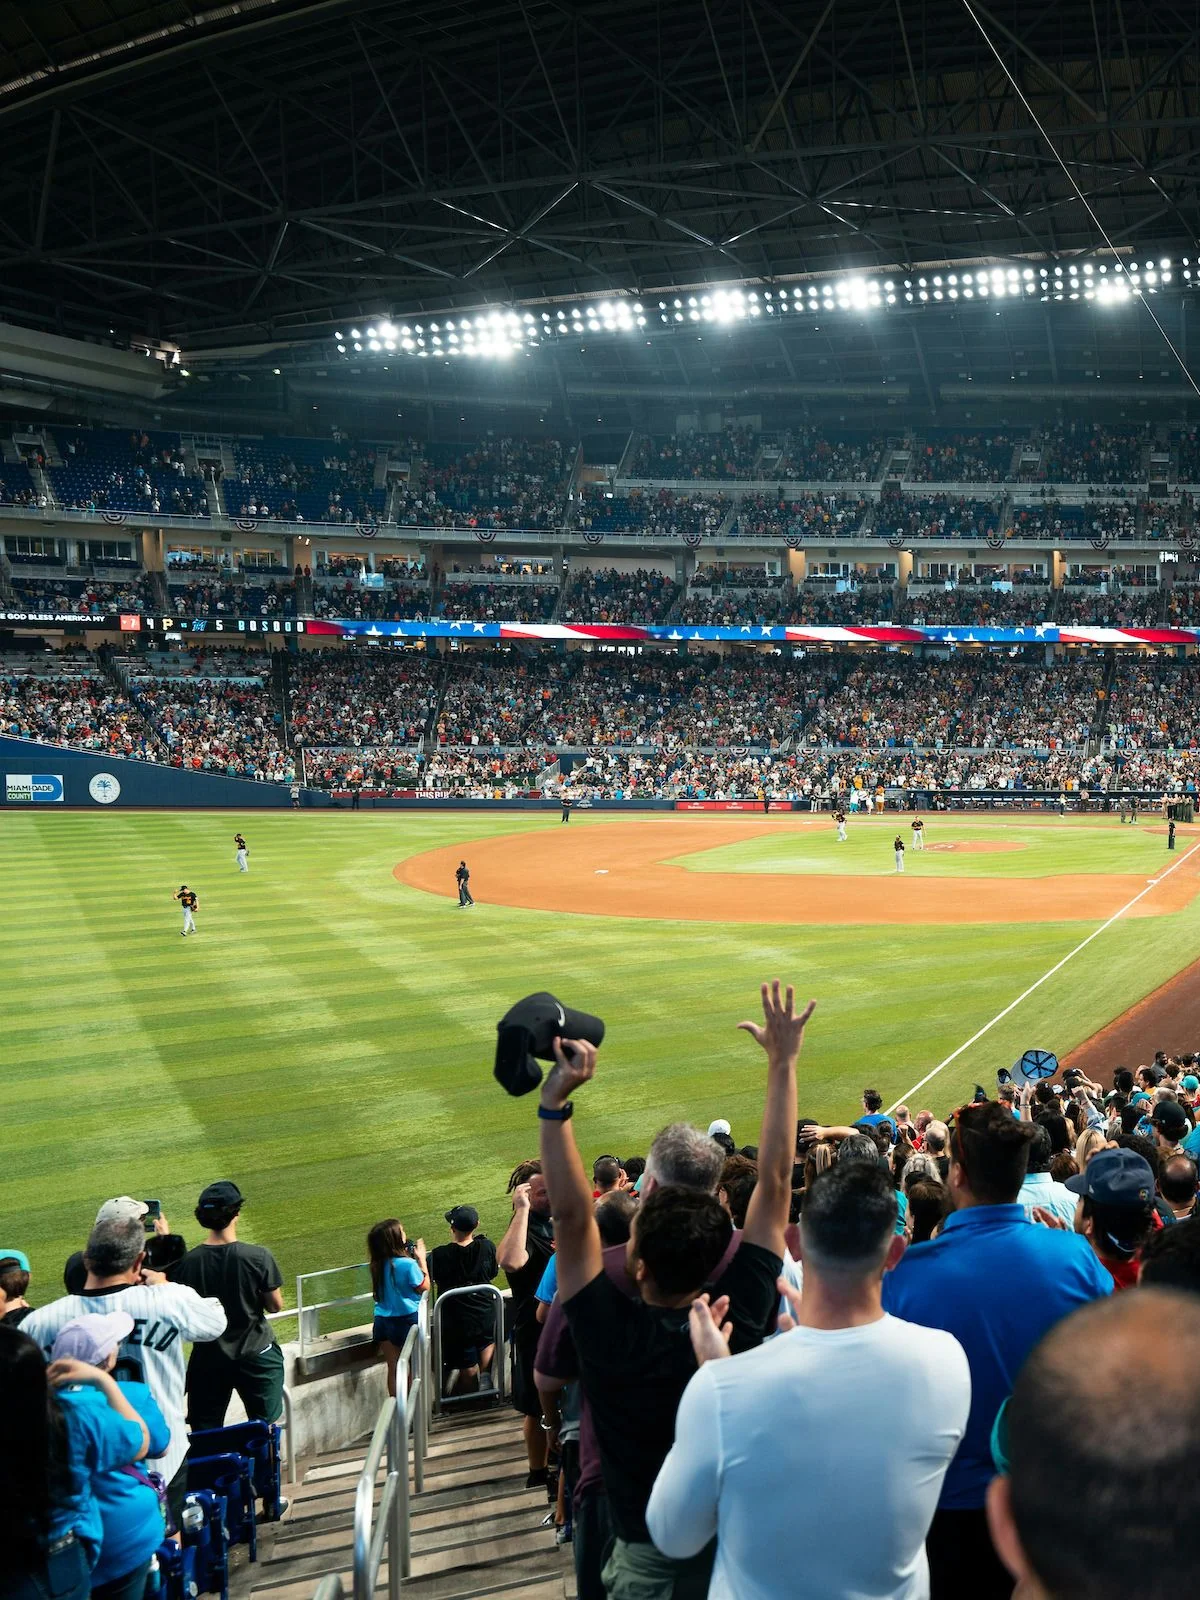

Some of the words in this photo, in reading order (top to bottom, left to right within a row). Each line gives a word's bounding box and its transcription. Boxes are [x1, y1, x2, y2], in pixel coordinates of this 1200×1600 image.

[55, 614, 92, 622] AMERICA
[147, 618, 154, 630] 4
[216, 619, 224, 631] 5
[8, 792, 30, 800] COUNTY
[415, 791, 434, 799] THIS
[128, 1318, 179, 1352] ELD
